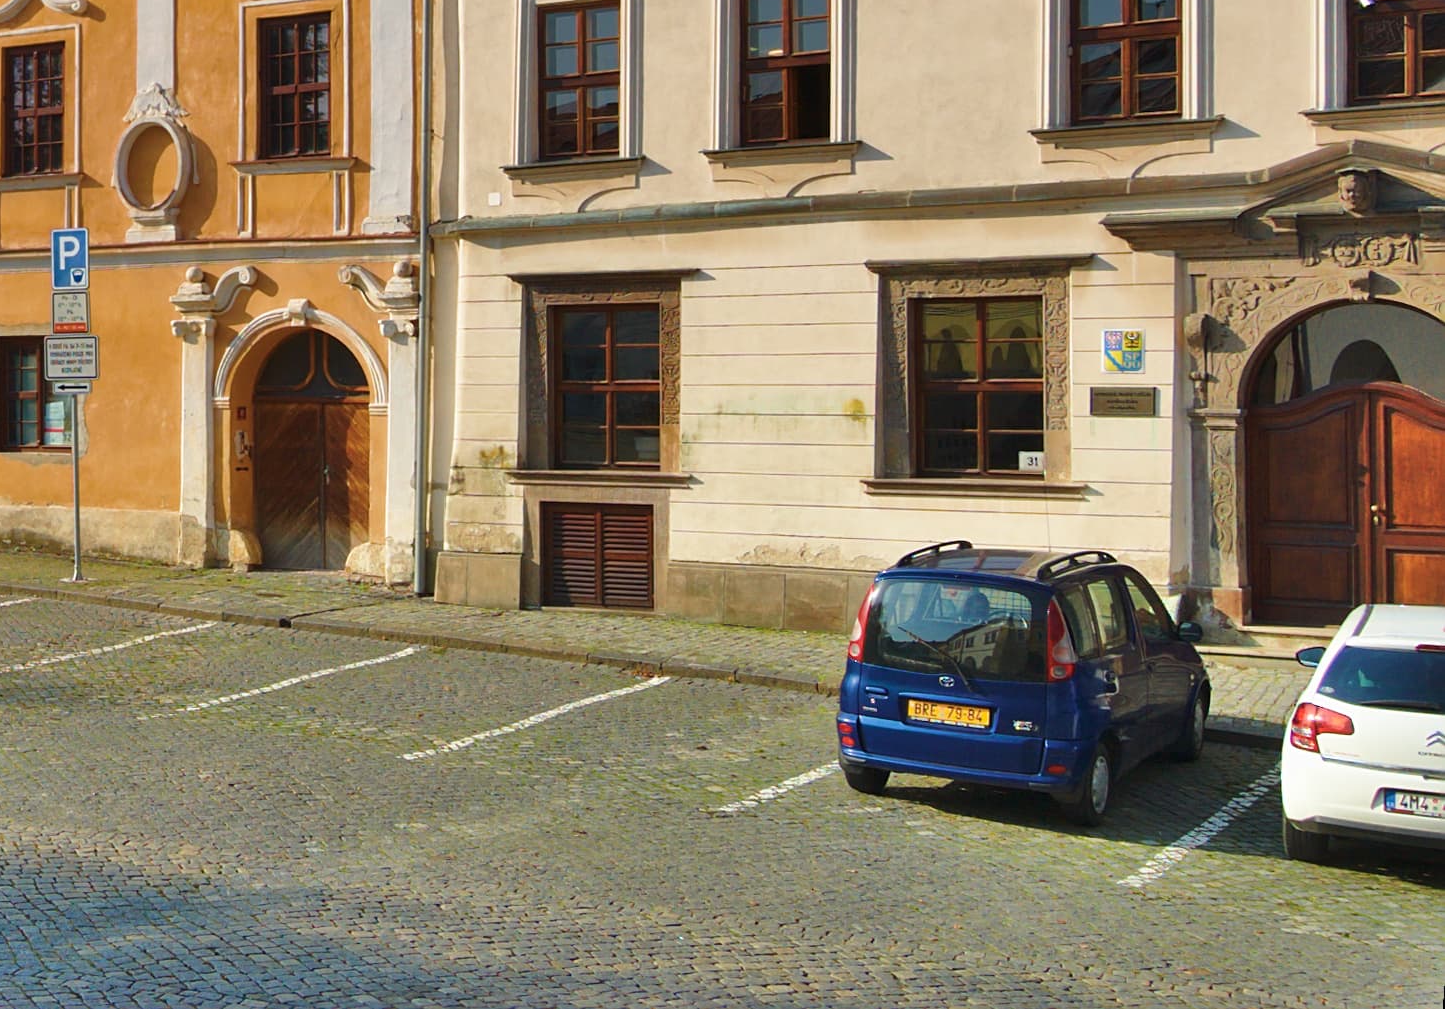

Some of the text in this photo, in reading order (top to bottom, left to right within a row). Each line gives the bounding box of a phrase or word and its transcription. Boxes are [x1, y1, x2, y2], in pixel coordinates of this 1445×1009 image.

[59, 236, 80, 270] P
[1027, 456, 1038, 467] 31
[914, 703, 983, 722] BRE 79-84
[1399, 794, 1429, 811] 4M4
